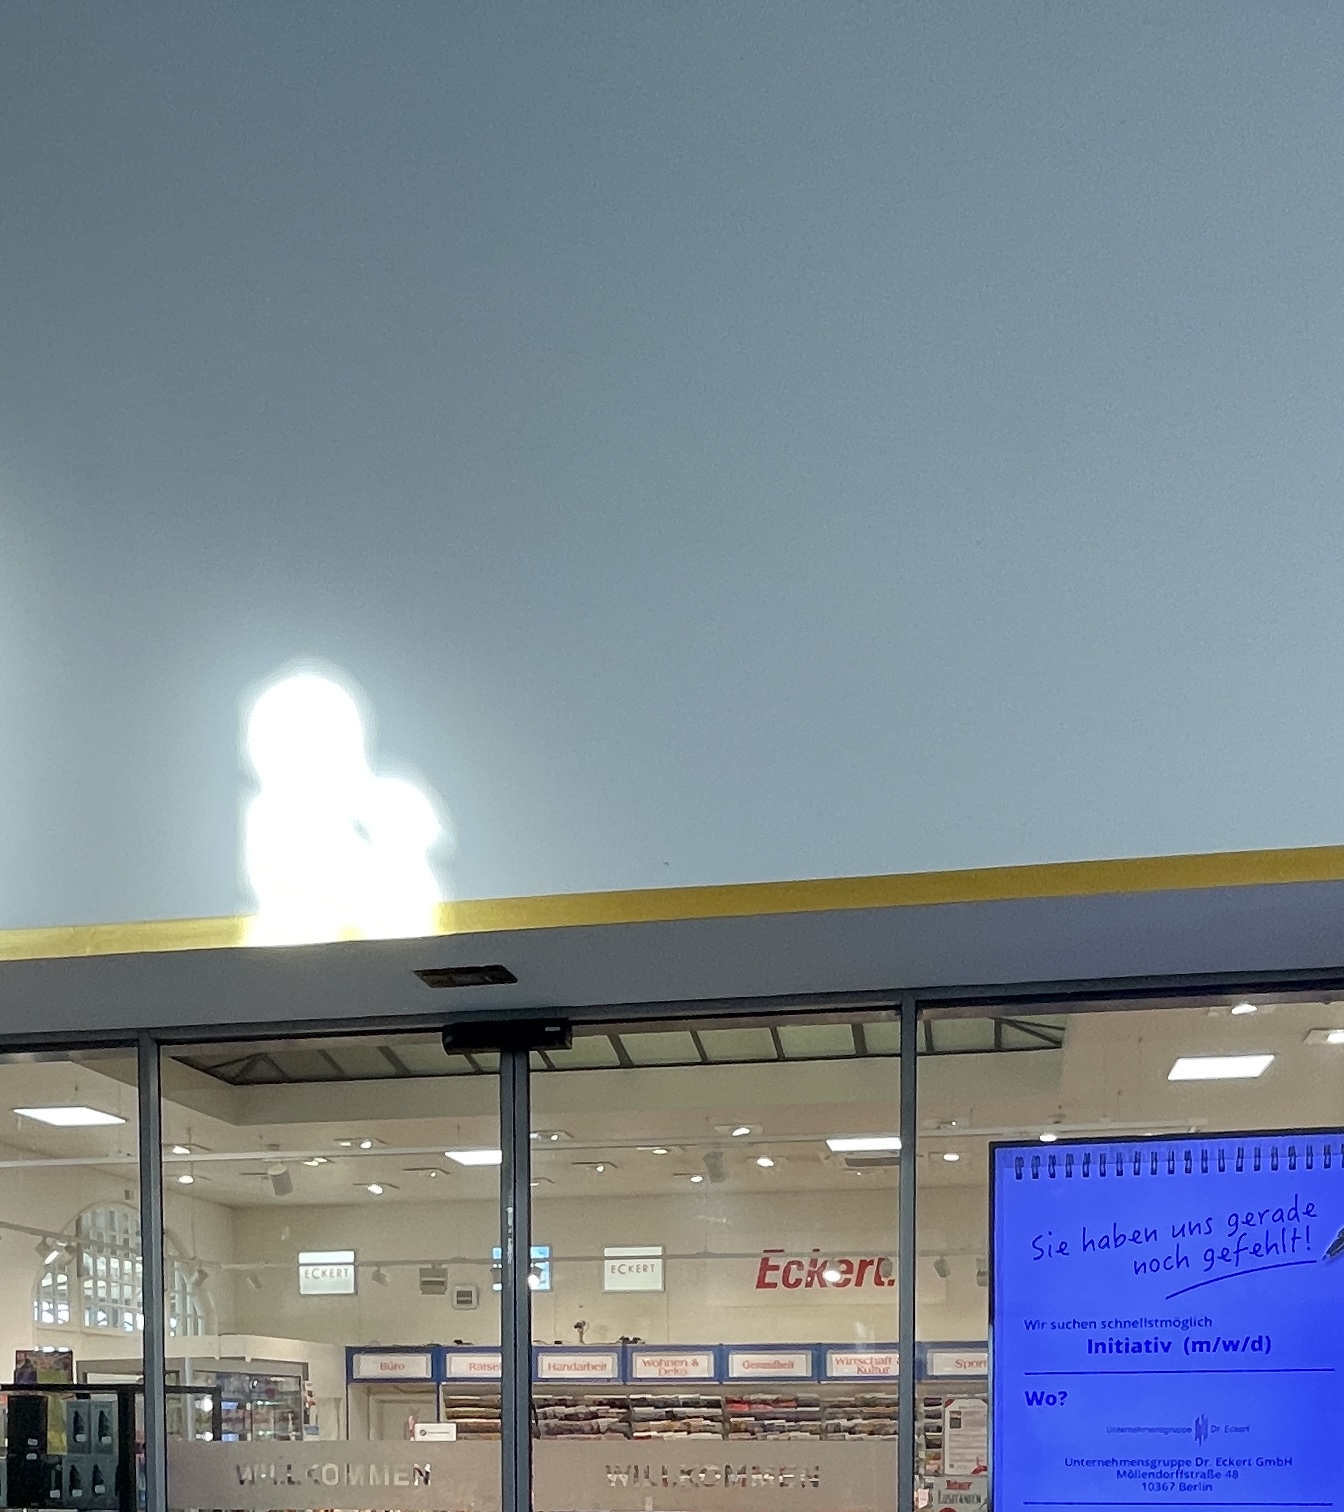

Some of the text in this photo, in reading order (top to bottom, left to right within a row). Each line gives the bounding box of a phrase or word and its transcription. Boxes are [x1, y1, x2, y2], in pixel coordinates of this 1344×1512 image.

[1031, 1193, 1317, 1261] Sie haben uns gerade
[1133, 1225, 1313, 1276] noch gefehlt!
[304, 1268, 350, 1280] ECKERT
[610, 1263, 656, 1275] ECKERT
[1024, 1315, 1213, 1333] Wir suchen schnellstmöglich
[1087, 1334, 1272, 1357] Initiativ (m/w/d)
[379, 1360, 405, 1372] Büro
[547, 1360, 608, 1373] Handarbeit
[642, 1358, 700, 1369] Wohnen &
[742, 1360, 795, 1371] Gesundheit
[835, 1355, 893, 1367] Wirtschaft
[658, 1367, 688, 1377] Deko
[856, 1365, 891, 1375] Kultur
[1025, 1390, 1068, 1407] Wo?
[1064, 1456, 1192, 1470] Unternehmensgruppe
[1215, 1456, 1253, 1467] Eckert
[1256, 1456, 1293, 1467] GmbH
[236, 1463, 431, 1486] WILLKOMMEN
[606, 1464, 819, 1488] WILLKOMMEN
[1116, 1467, 1239, 1481] Möllendorffstraße 48
[1179, 1481, 1213, 1492] Berlin
